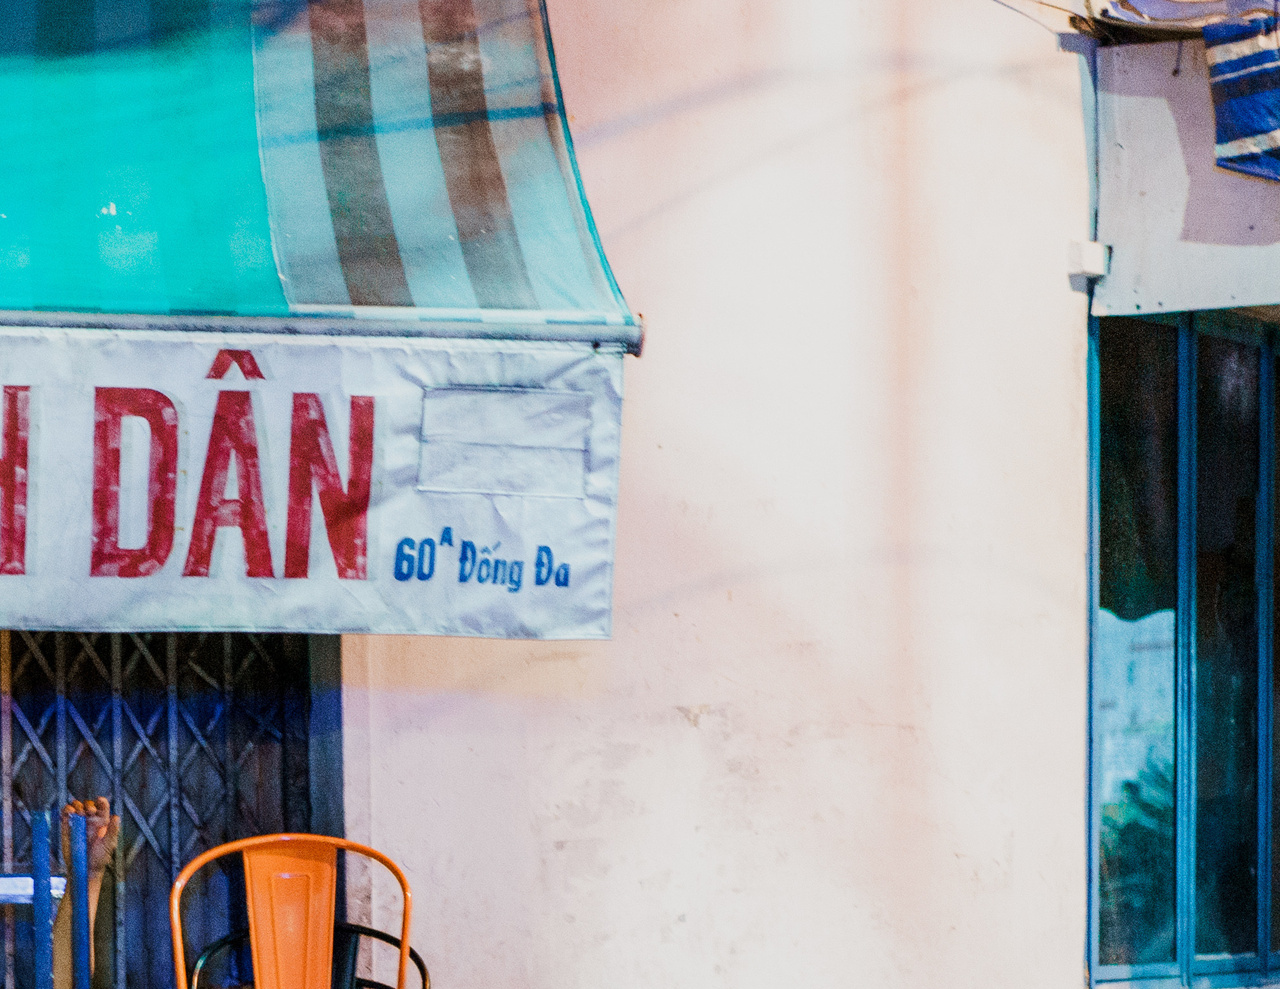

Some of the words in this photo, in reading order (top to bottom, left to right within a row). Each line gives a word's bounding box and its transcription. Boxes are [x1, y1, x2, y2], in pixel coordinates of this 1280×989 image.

[89, 349, 375, 580] DÂN
[393, 527, 453, 582] 60A
[458, 540, 524, 593] Đống
[535, 545, 570, 587] Đa
